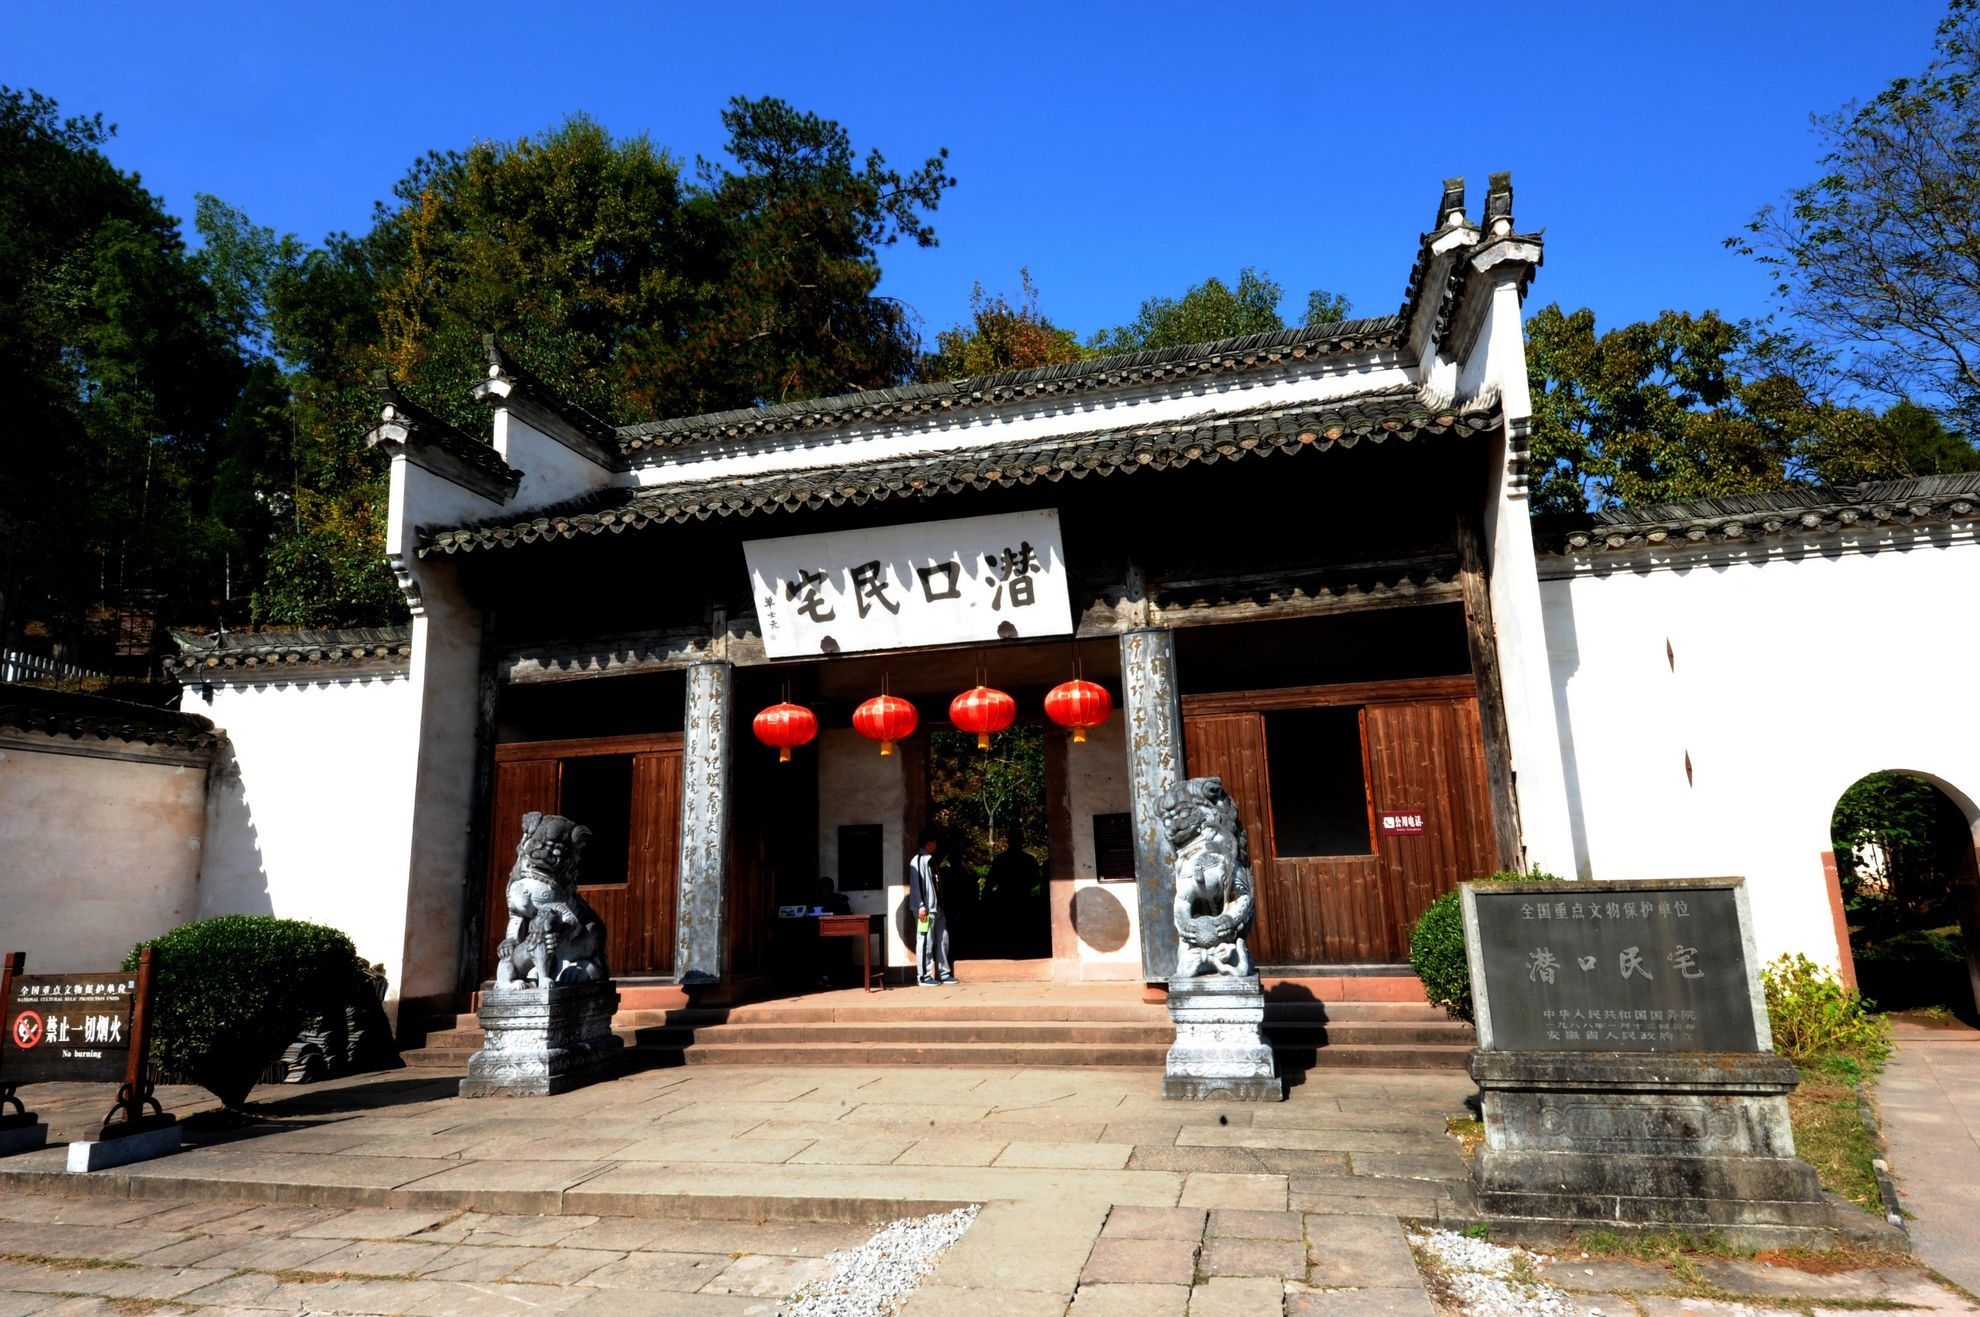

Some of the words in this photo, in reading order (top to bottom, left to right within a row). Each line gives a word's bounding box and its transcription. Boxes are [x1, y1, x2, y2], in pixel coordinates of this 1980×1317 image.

[786, 541, 1041, 624] 潜口民宅
[1394, 815, 1423, 828] 公用电话
[1521, 900, 1691, 920] 全国重点文物保护单位
[1525, 945, 1705, 984] 潜口民宅
[20, 983, 126, 996] 全国重点文物保护单位
[1543, 1009, 1696, 1021] 中华人民共和国国务院
[45, 1015, 121, 1043] 禁止一切烟火
[62, 1049, 72, 1058] No
[74, 1049, 102, 1059] burning
